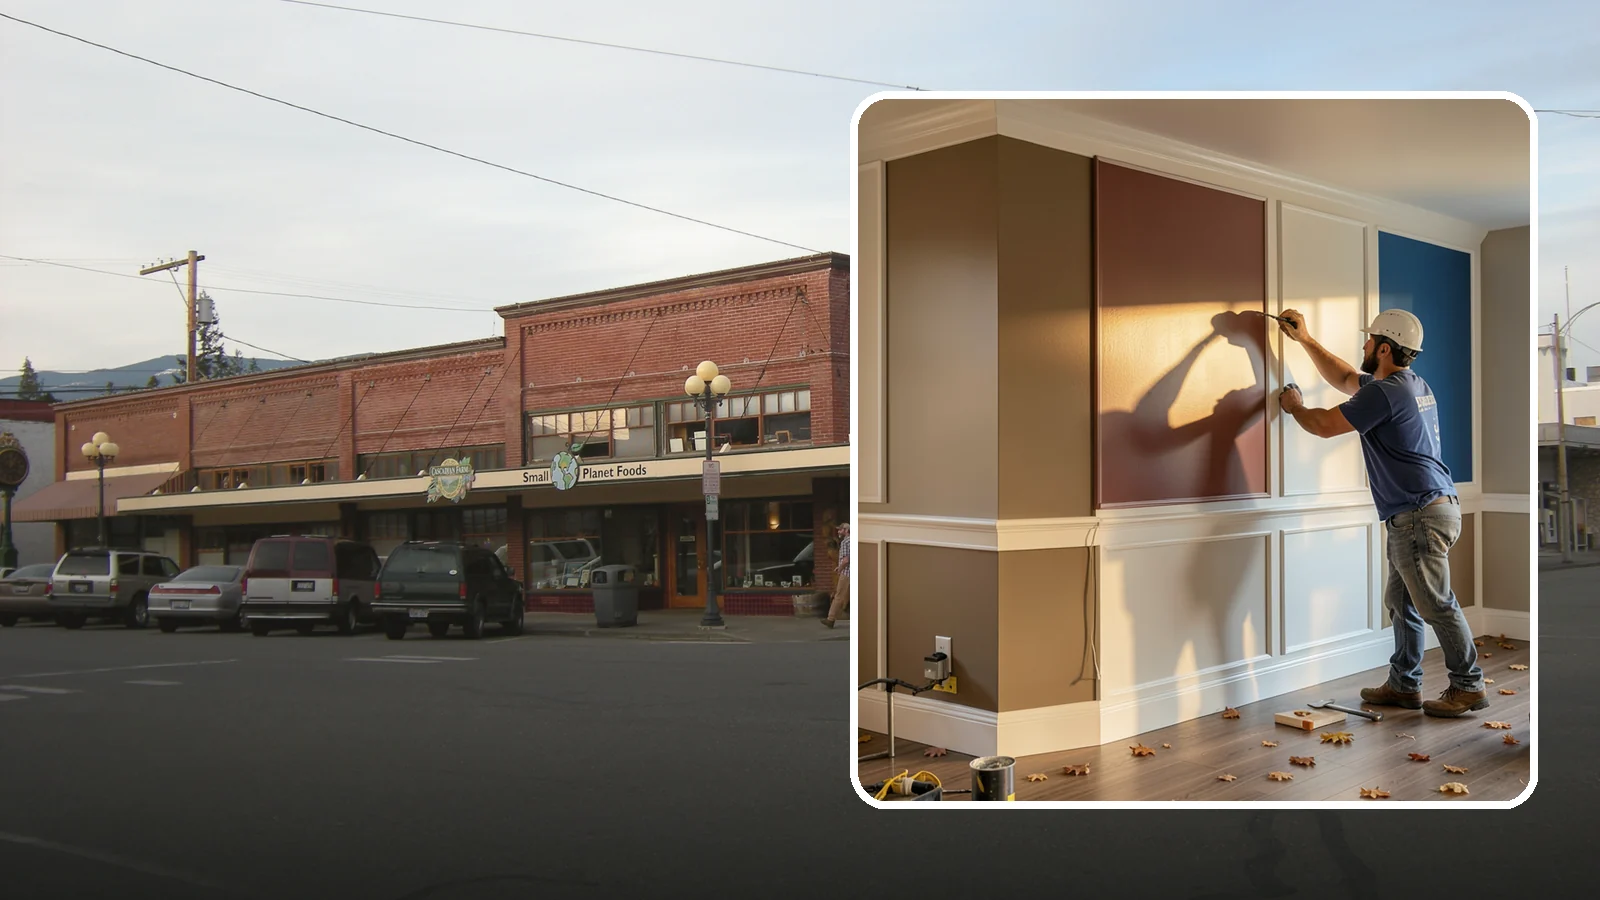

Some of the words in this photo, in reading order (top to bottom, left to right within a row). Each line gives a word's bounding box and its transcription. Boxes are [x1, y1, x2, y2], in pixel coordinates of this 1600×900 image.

[523, 471, 549, 483] Small
[583, 467, 614, 480] Planet
[617, 464, 647, 477] Foods
